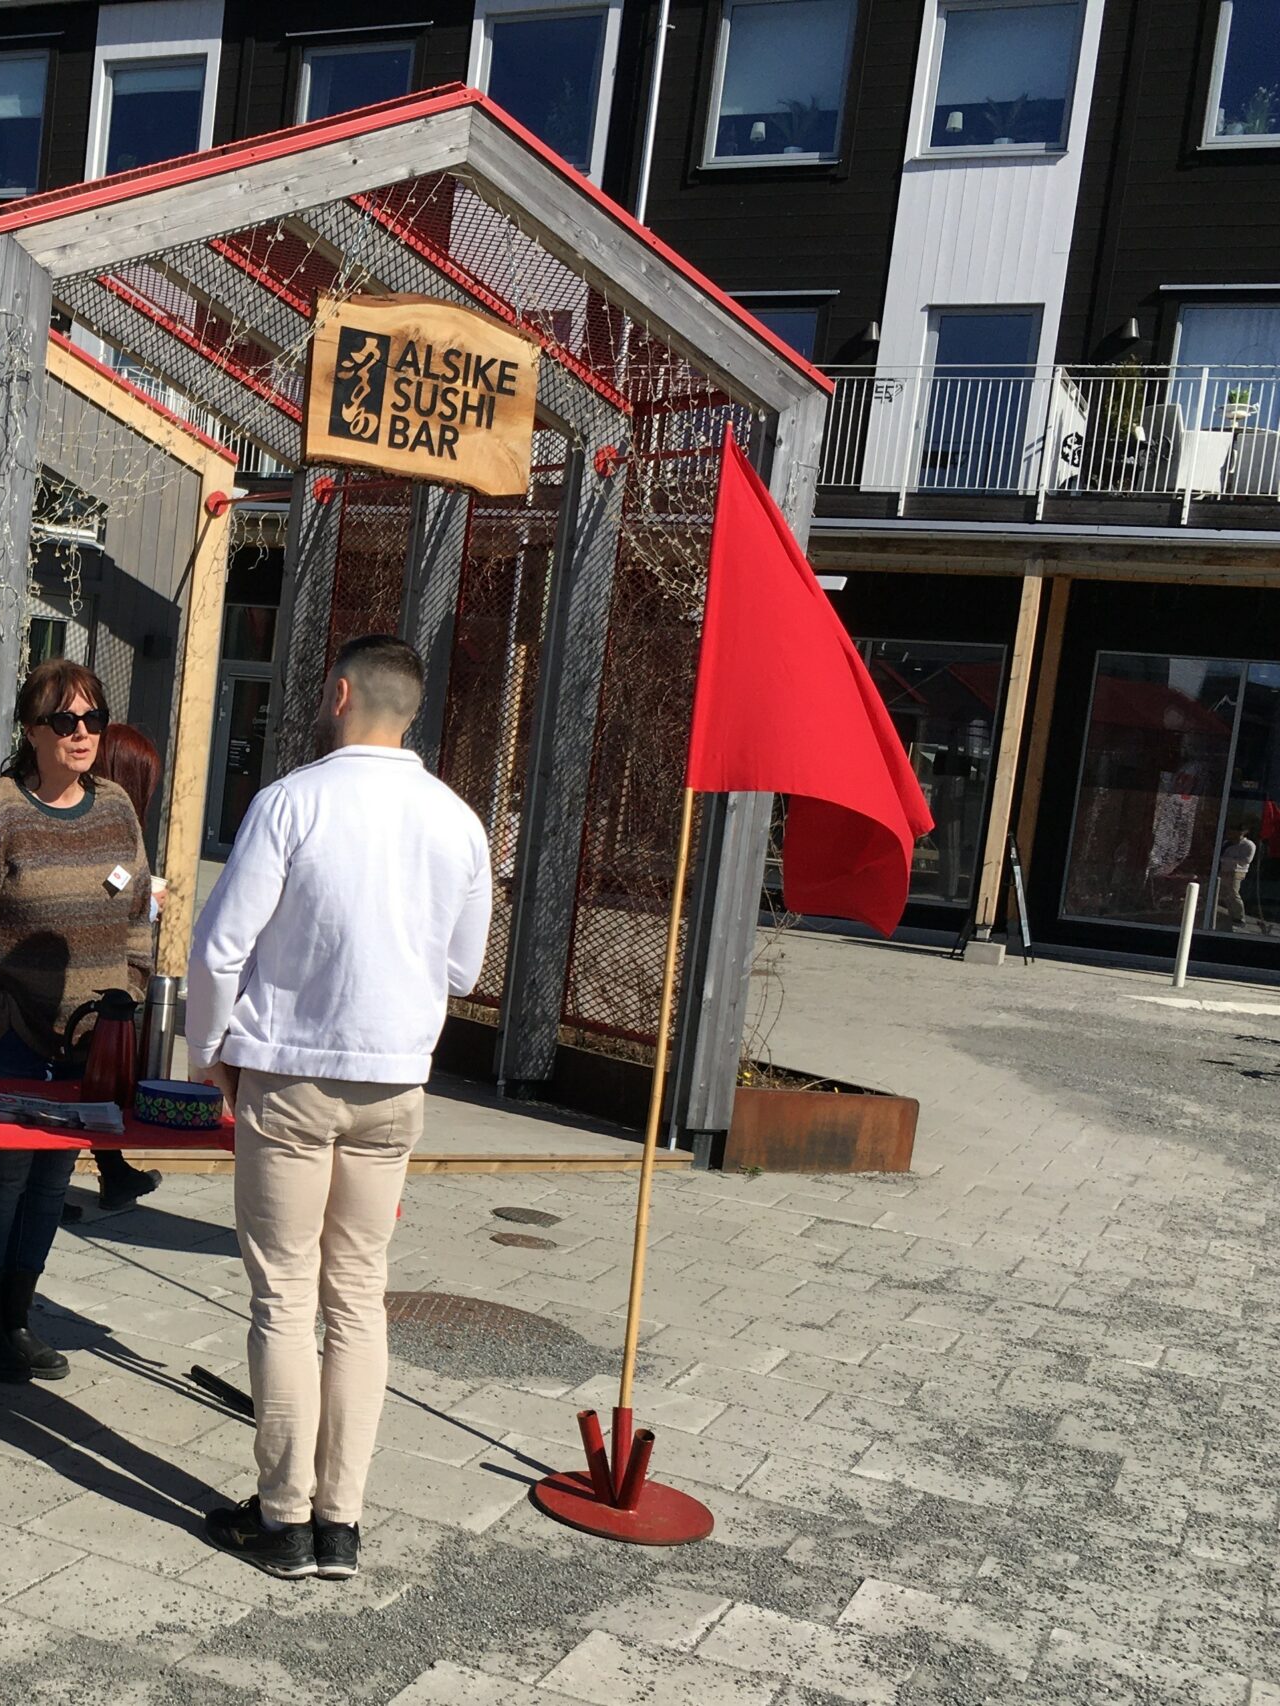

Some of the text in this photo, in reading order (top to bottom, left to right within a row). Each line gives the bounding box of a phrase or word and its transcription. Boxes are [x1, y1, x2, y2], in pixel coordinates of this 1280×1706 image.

[394, 340, 518, 396] ALSIKE
[391, 377, 496, 430] SUSHI
[388, 414, 460, 461] BAR
